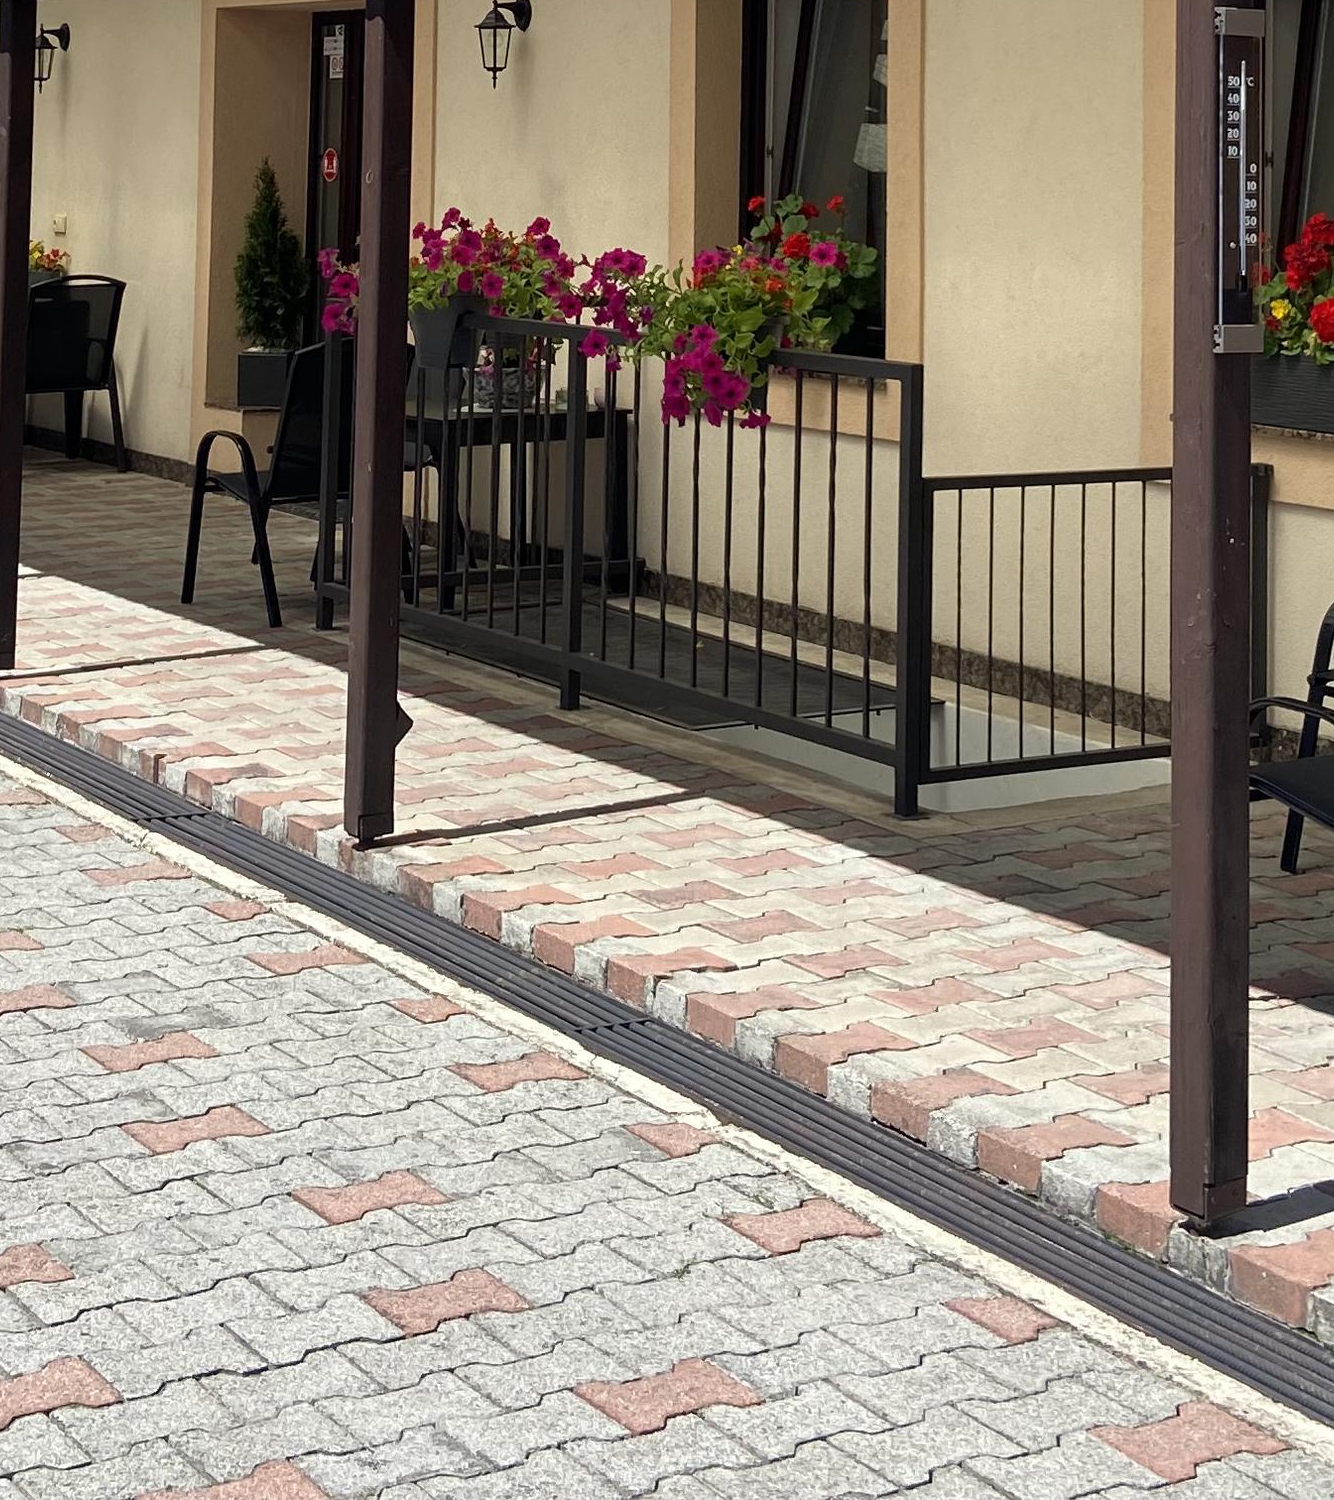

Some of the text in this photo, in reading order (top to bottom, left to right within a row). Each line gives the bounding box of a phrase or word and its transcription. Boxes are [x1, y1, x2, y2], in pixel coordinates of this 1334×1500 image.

[1227, 93, 1240, 104] 40
[1227, 110, 1240, 121] 30
[1227, 128, 1240, 138] 20
[1228, 145, 1238, 156] 10
[1249, 163, 1257, 173] 0
[1247, 181, 1257, 191] 10
